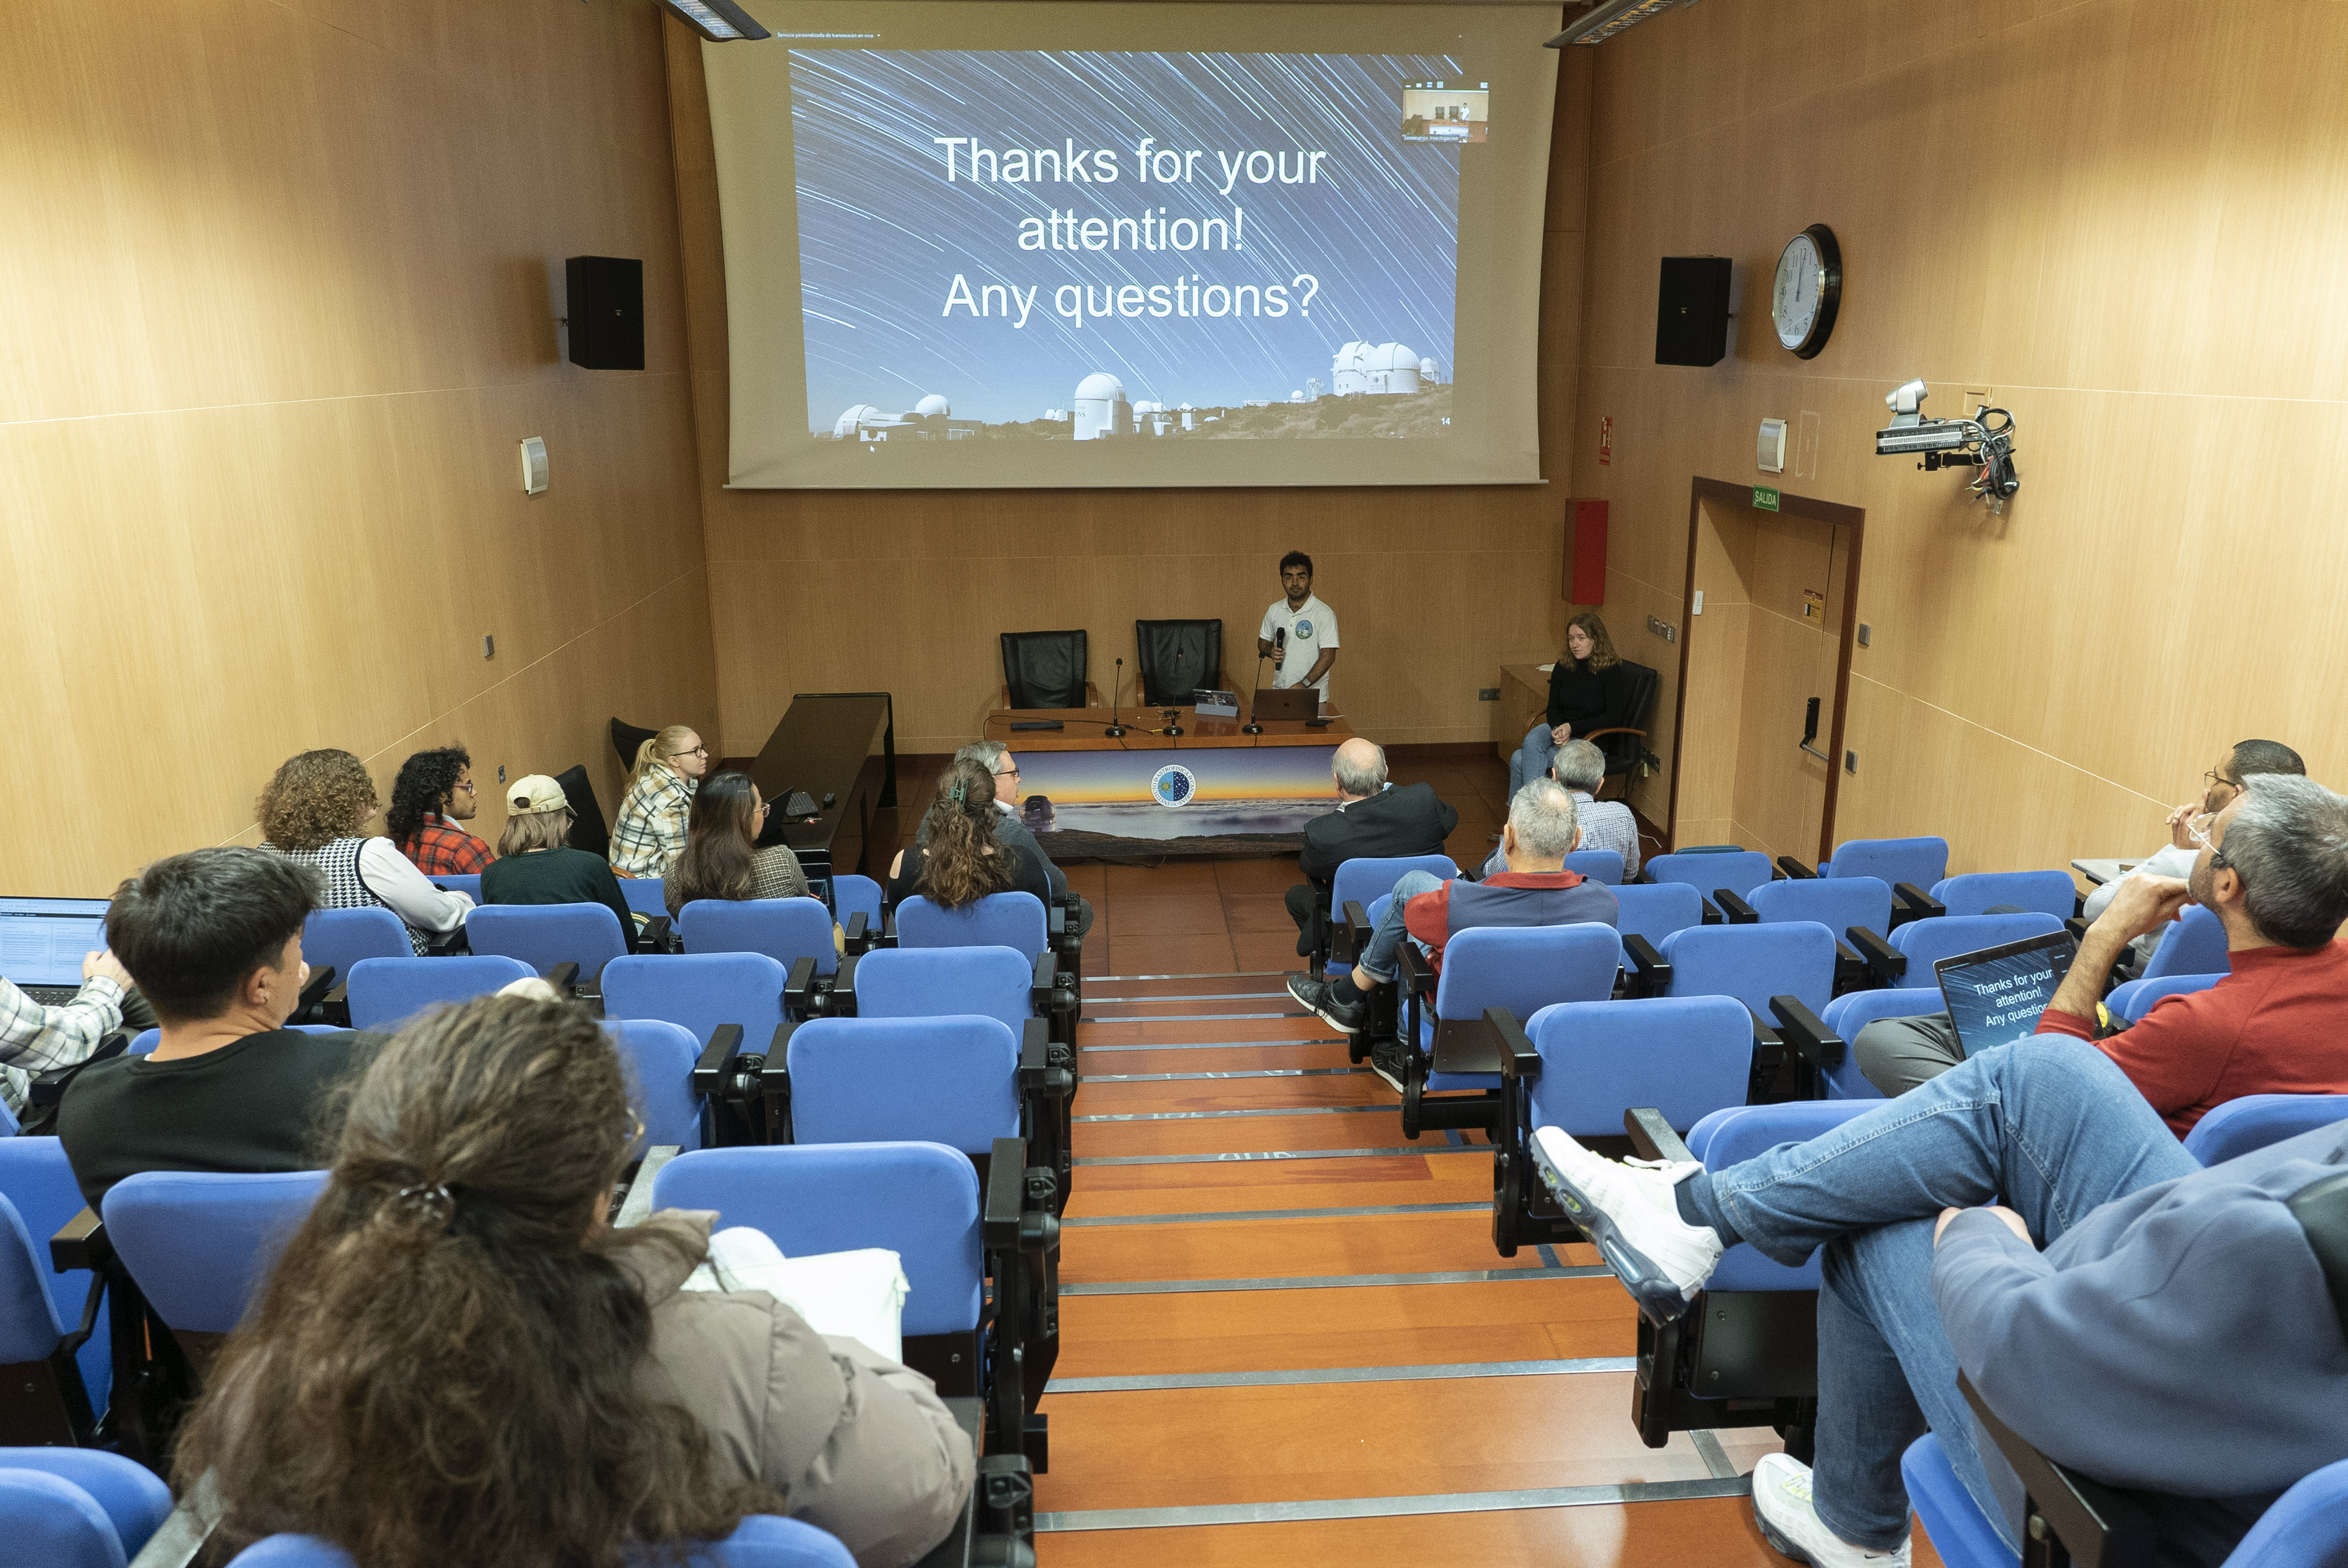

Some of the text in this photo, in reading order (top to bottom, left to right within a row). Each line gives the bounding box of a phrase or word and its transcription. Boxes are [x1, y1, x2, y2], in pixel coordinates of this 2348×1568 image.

[934, 138, 1326, 196] Thanks for your
[1018, 206, 1243, 251] attention!
[941, 274, 1319, 329] Any questions?
[1441, 417, 1451, 426] 14
[1755, 490, 1777, 506] SALIDA
[1973, 969, 2052, 996] Thanks for your
[1995, 986, 2042, 1008] attention!
[1986, 1014, 2005, 1027] Any
